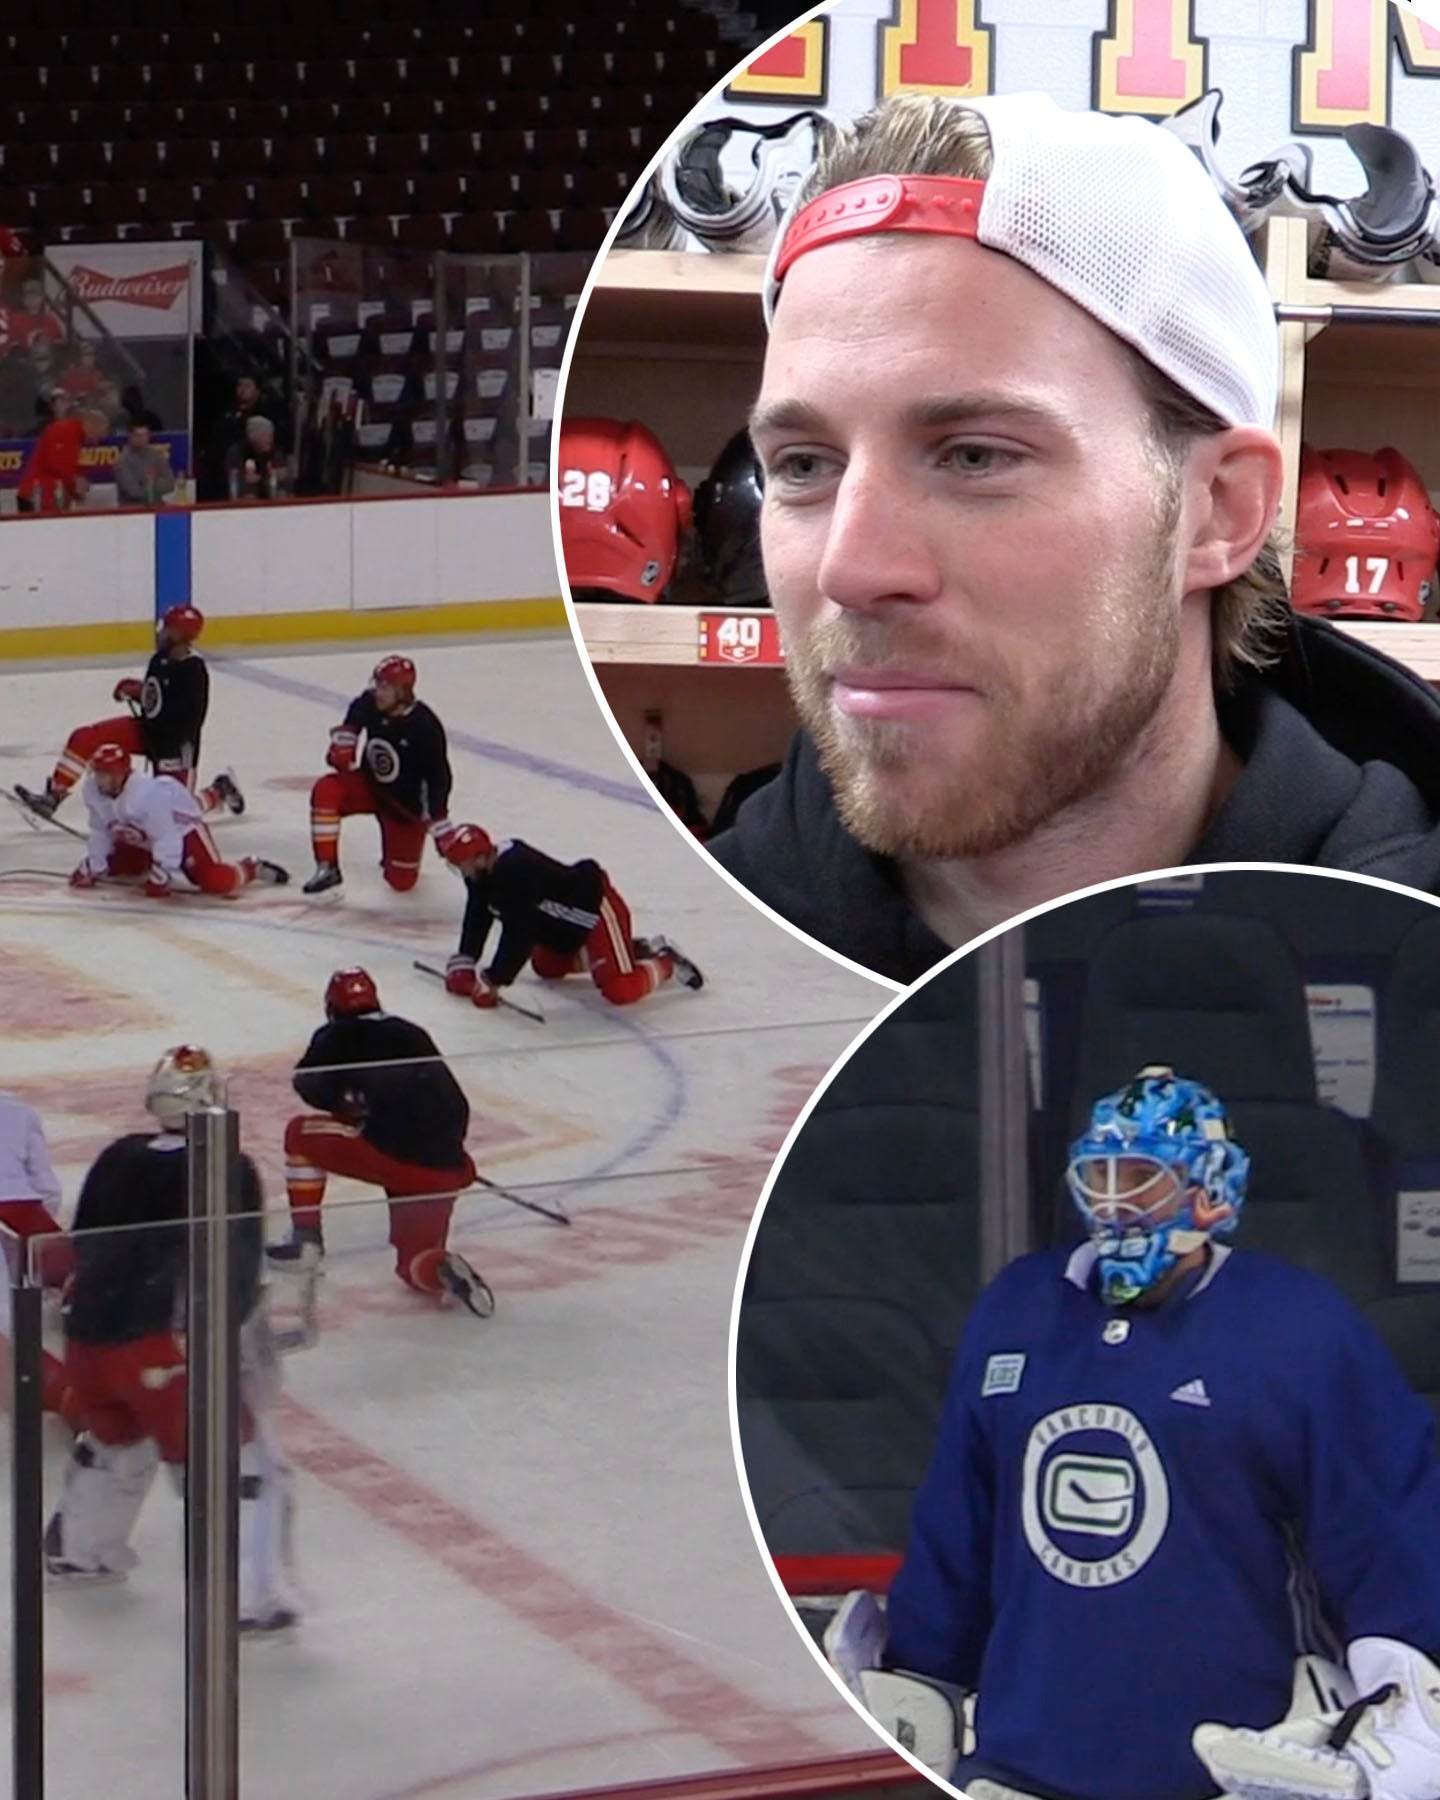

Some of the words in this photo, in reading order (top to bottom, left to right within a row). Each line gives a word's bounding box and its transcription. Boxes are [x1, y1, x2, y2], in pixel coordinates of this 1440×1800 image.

[562, 470, 611, 508] 28
[1345, 556, 1389, 594] 17
[717, 617, 761, 646] 40
[1040, 1543, 1137, 1585] CANUCKS
